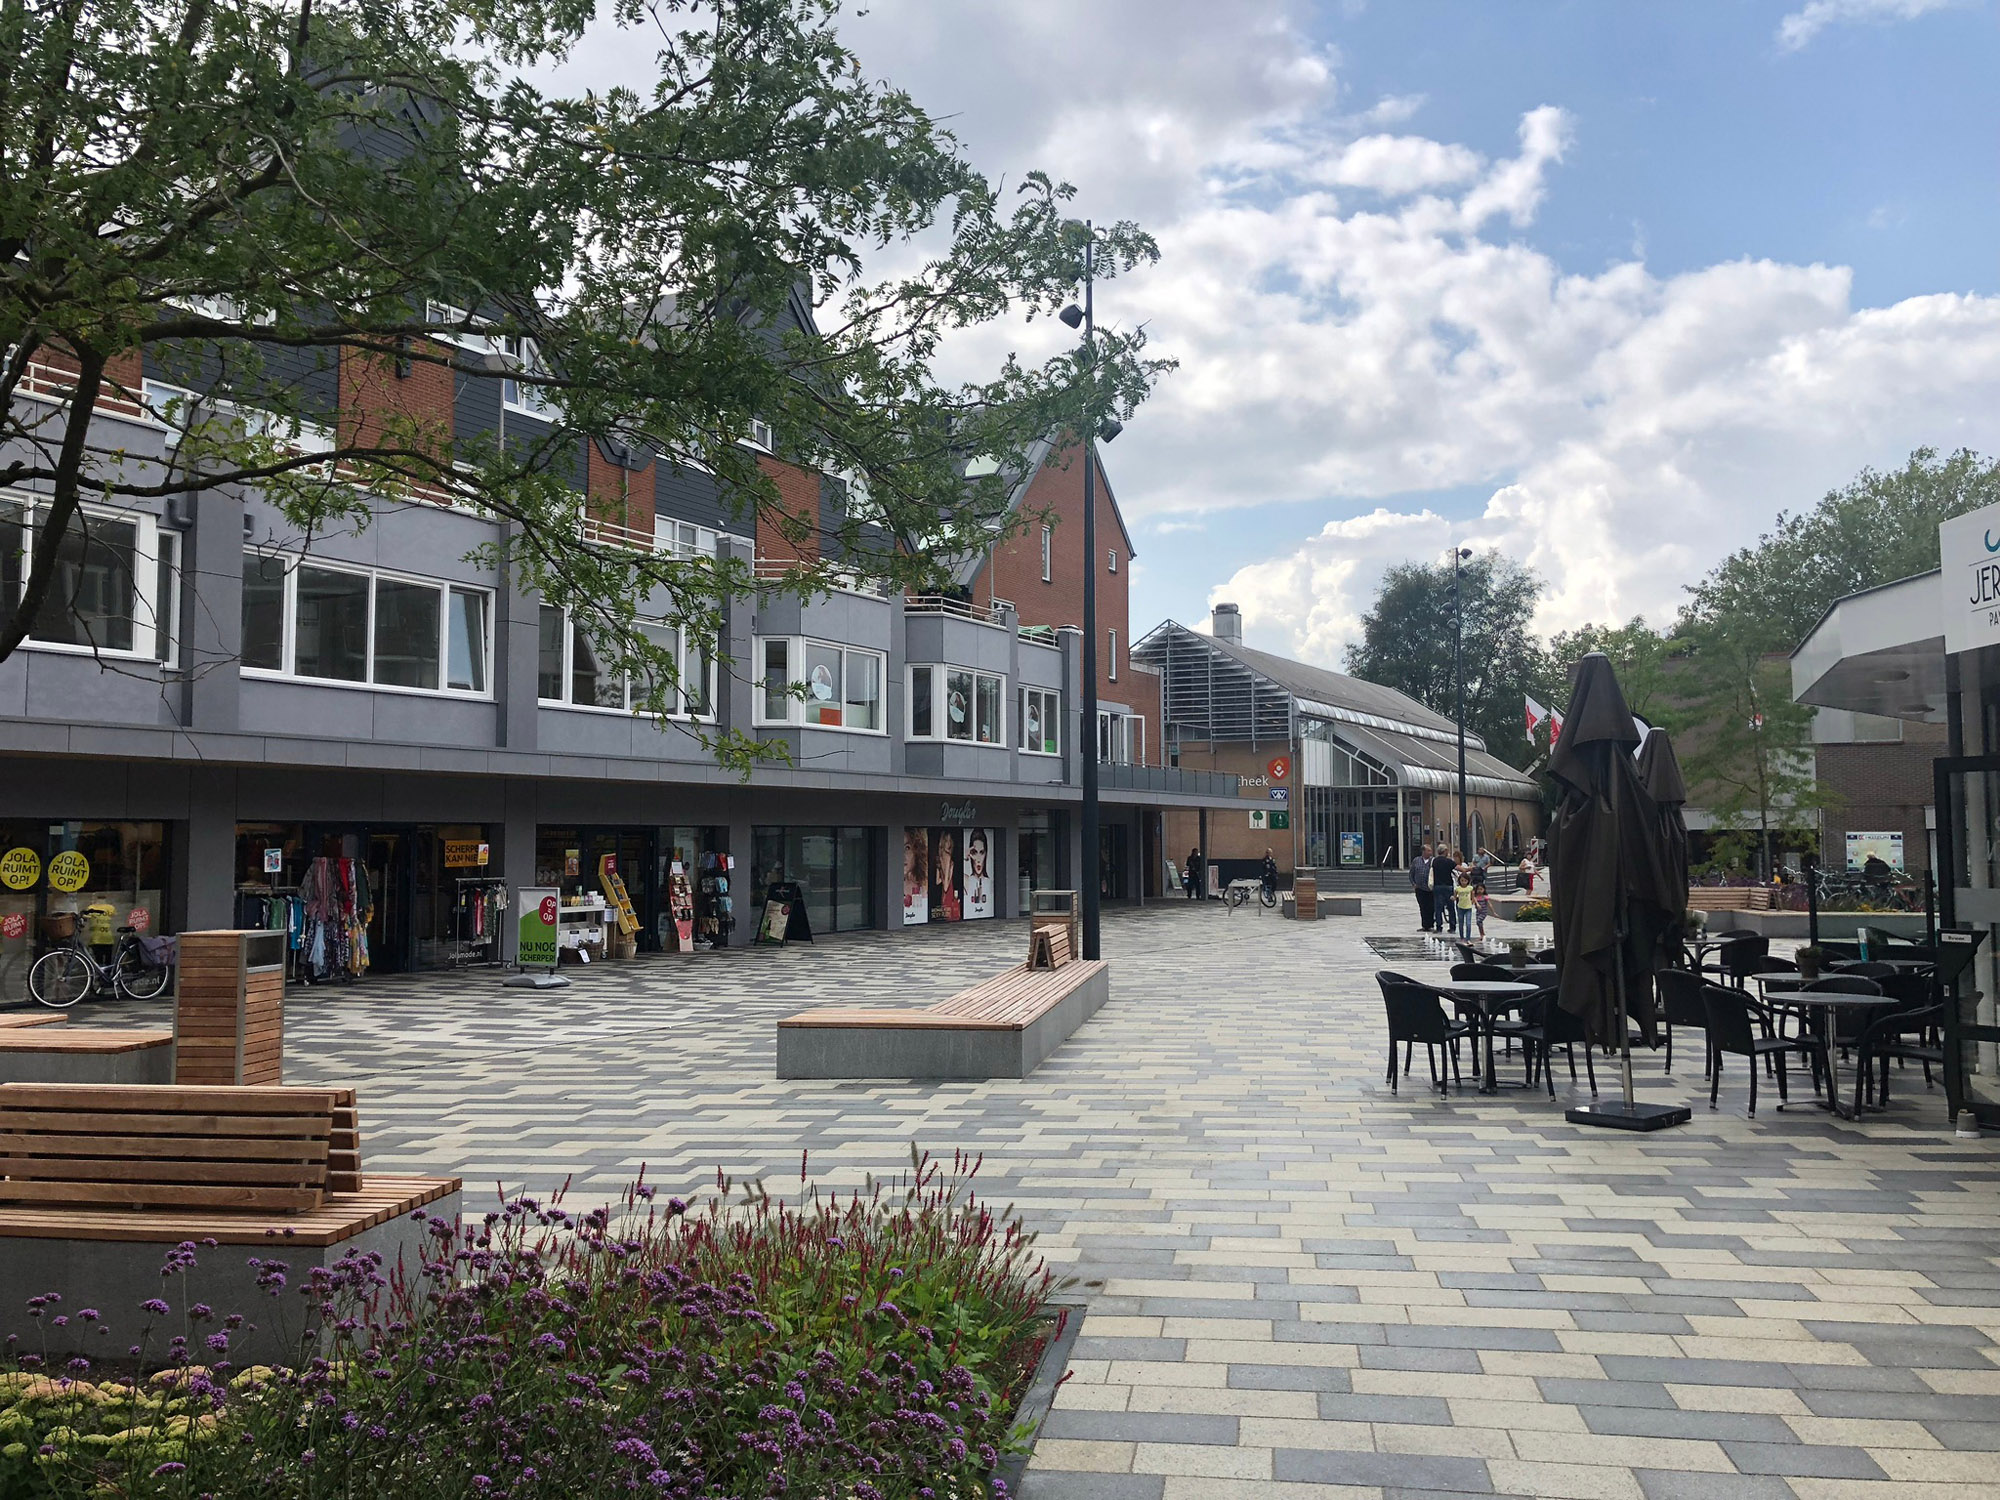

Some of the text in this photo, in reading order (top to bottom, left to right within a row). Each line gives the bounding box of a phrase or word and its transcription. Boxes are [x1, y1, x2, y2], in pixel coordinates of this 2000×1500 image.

[1989, 610, 2000, 627] PA
[8, 852, 37, 863] JOLA
[57, 855, 86, 868] JOLA
[2, 862, 39, 874] RUIMT
[51, 864, 87, 879] RUIMT
[9, 874, 30, 885] OP!
[57, 876, 77, 888] OP!
[4, 914, 23, 925] JOLA
[129, 909, 148, 919] JOLA
[3, 920, 25, 932] RUIMT
[519, 941, 556, 952] NU NOG
[519, 953, 556, 963] SCHERPER!
